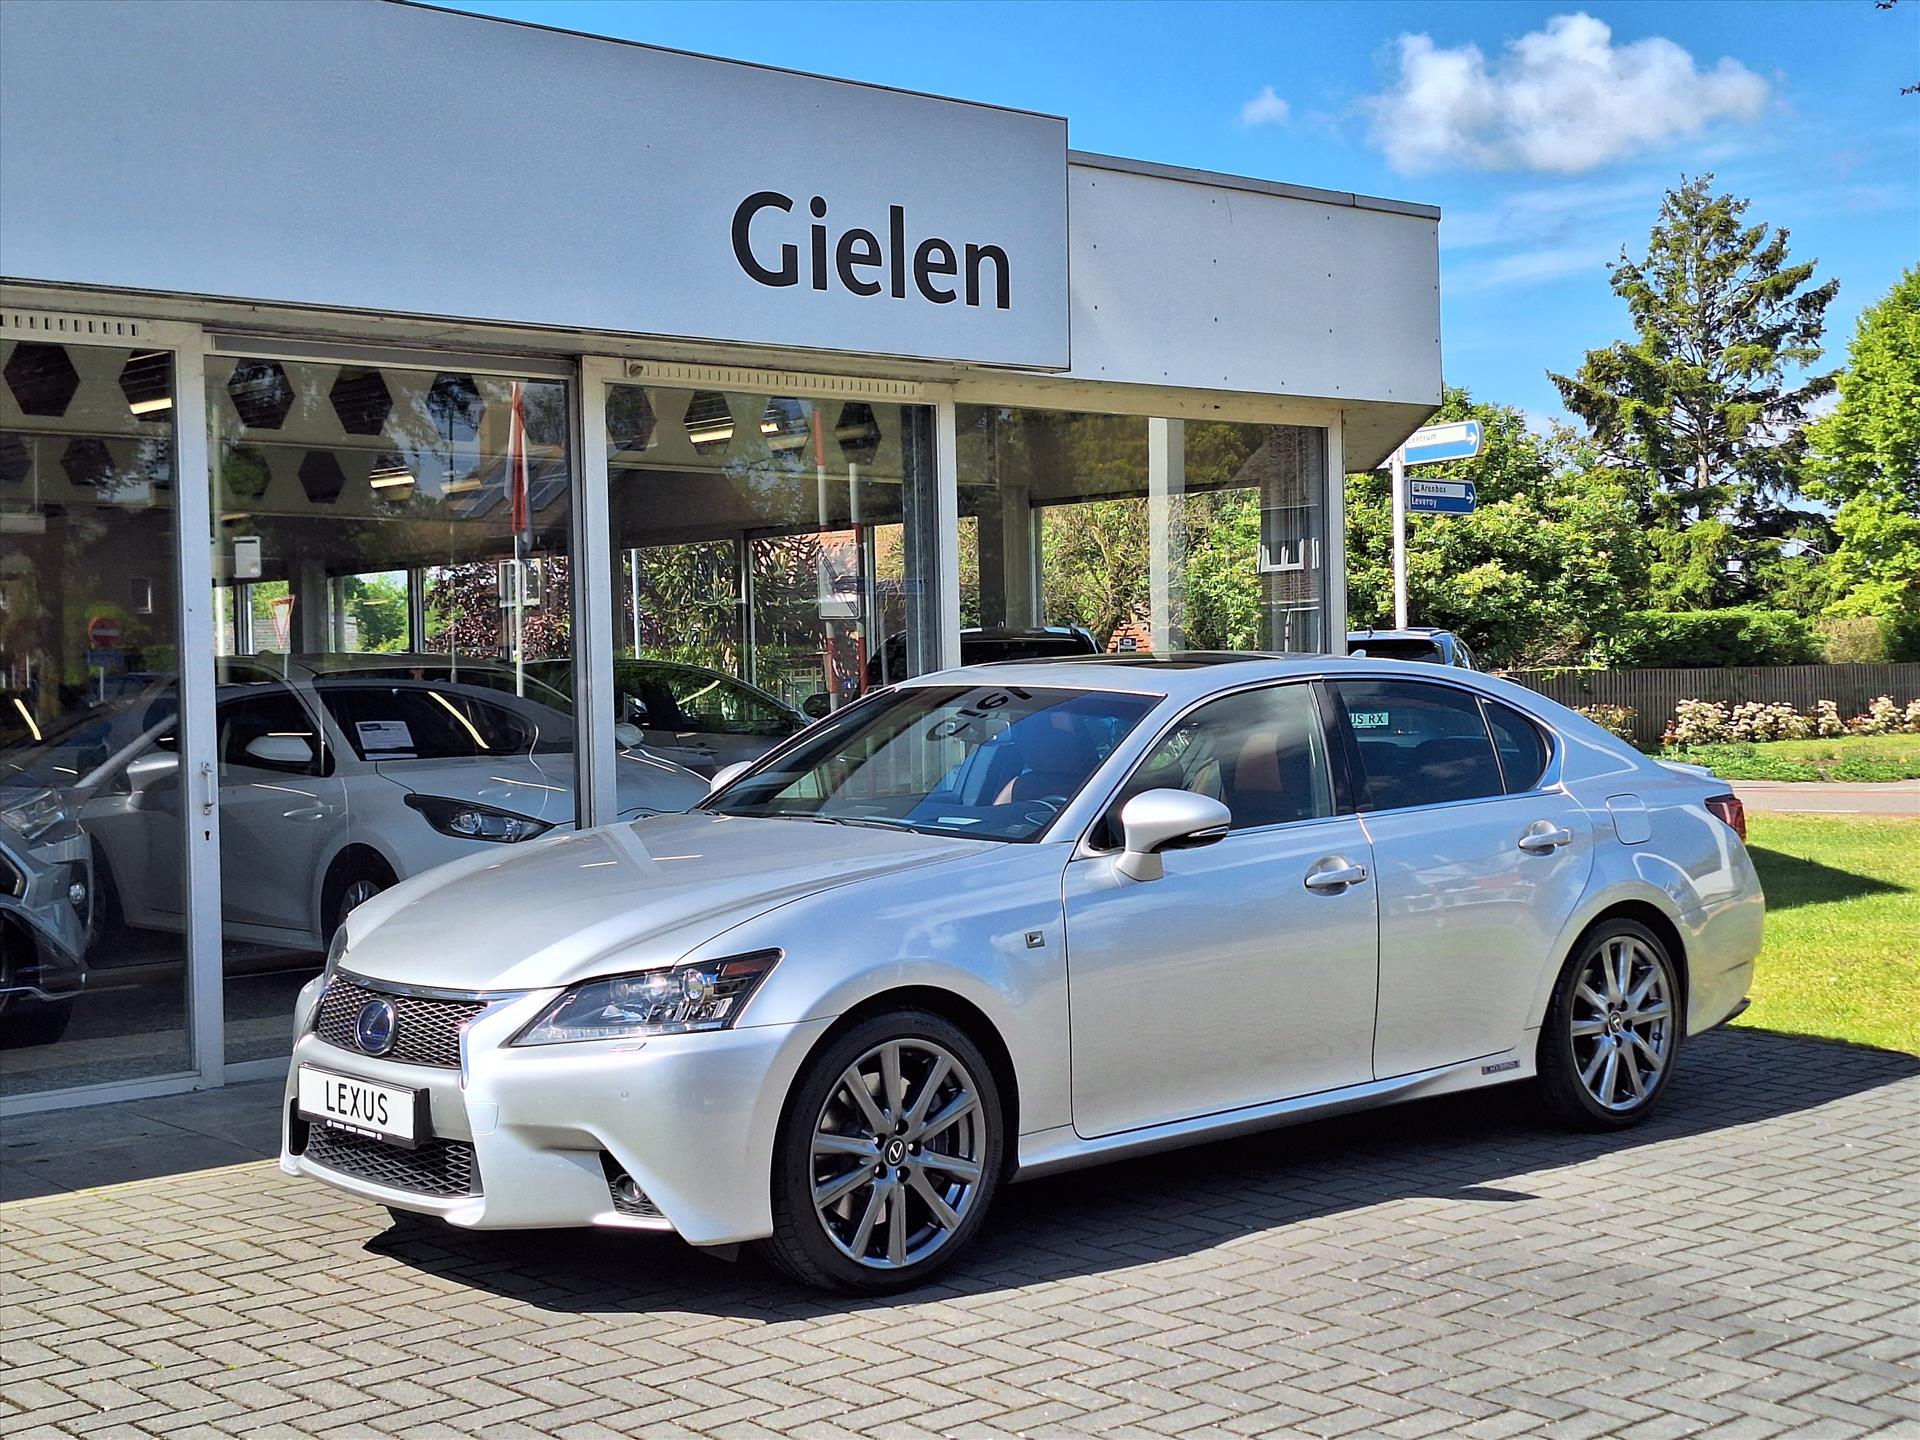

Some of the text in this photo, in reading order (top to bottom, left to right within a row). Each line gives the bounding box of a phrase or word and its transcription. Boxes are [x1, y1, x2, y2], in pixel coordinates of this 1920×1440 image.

[731, 191, 1010, 309] Gielen
[1408, 433, 1437, 443] entrum
[1412, 496, 1437, 508] Leveroy
[1368, 713, 1384, 724] RX
[325, 1080, 388, 1125] LEXUS
